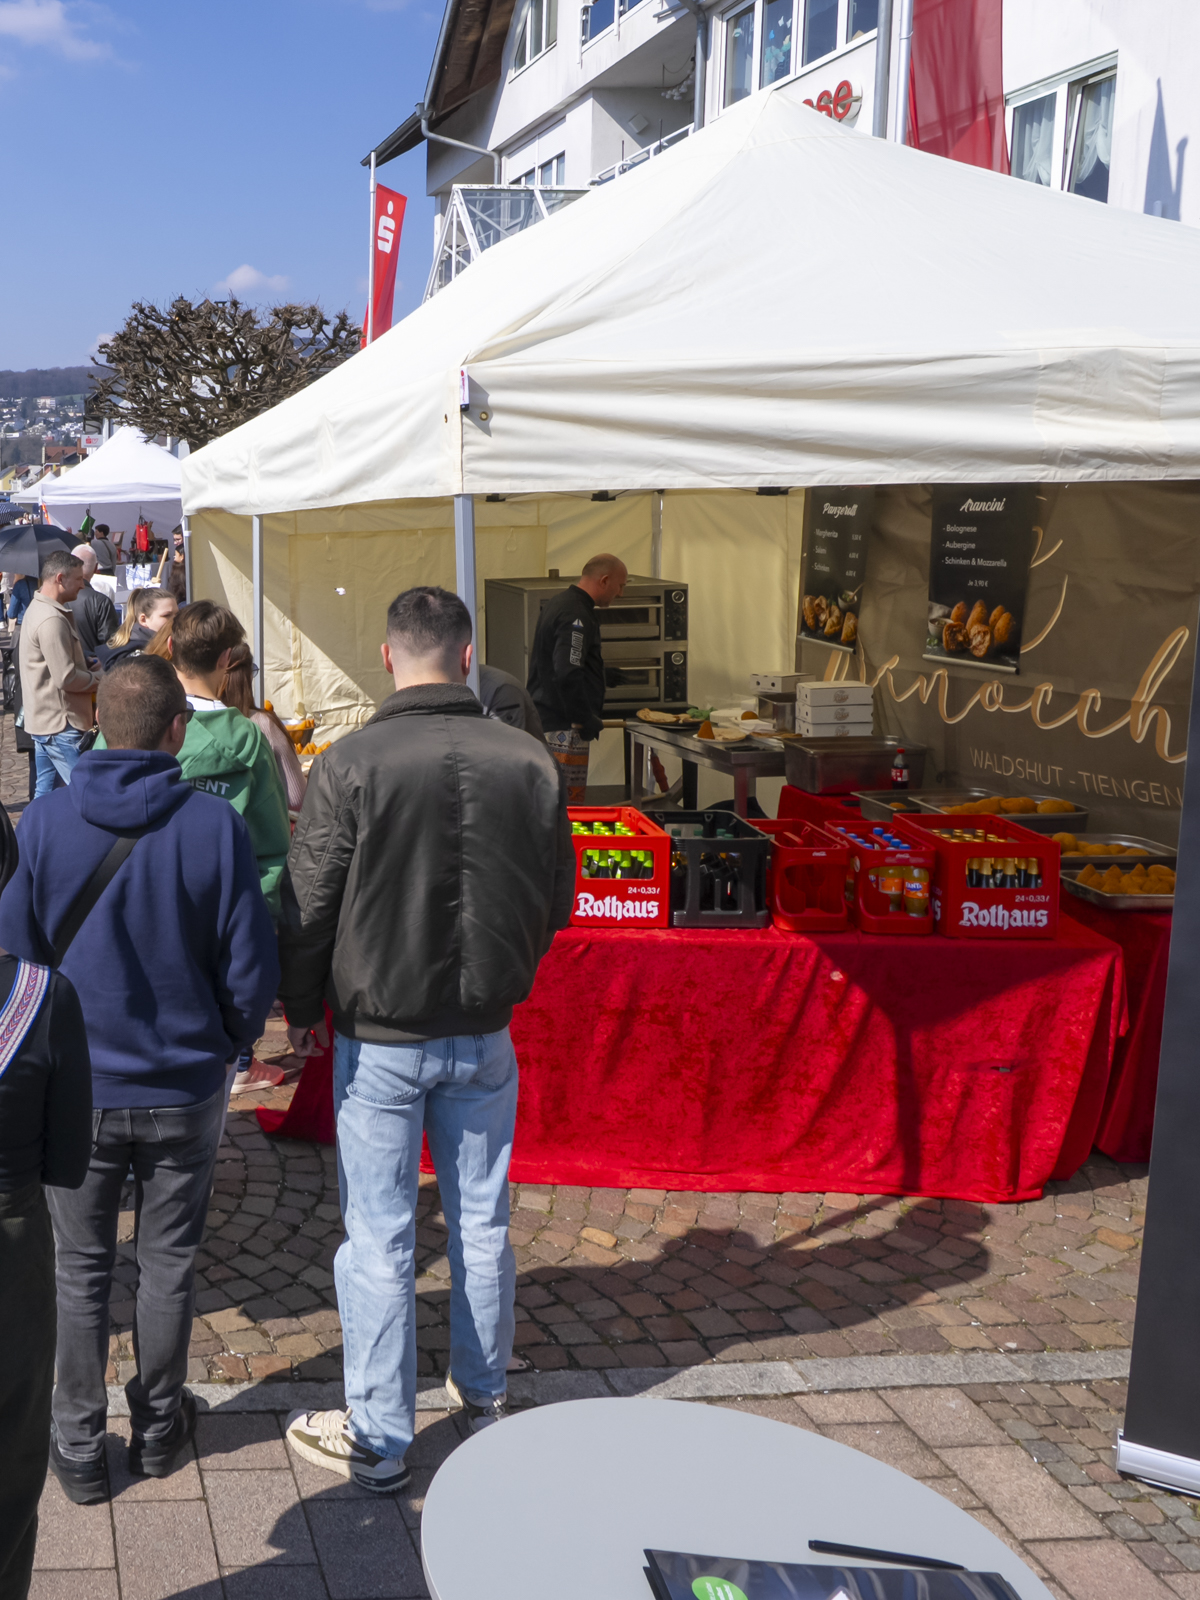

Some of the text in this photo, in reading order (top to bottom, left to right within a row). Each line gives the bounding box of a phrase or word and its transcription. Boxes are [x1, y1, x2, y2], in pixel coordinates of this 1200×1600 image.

[959, 498, 1006, 512] Arancini
[946, 524, 977, 534] Bolognese
[945, 541, 976, 551] Aubergine
[944, 556, 1007, 567] Schinken & Mozzarella
[969, 746, 1064, 788] WALDSHUT
[1077, 770, 1184, 808] TIENGEN
[574, 892, 660, 921] Rothaus
[958, 901, 1049, 930] Rothaus
